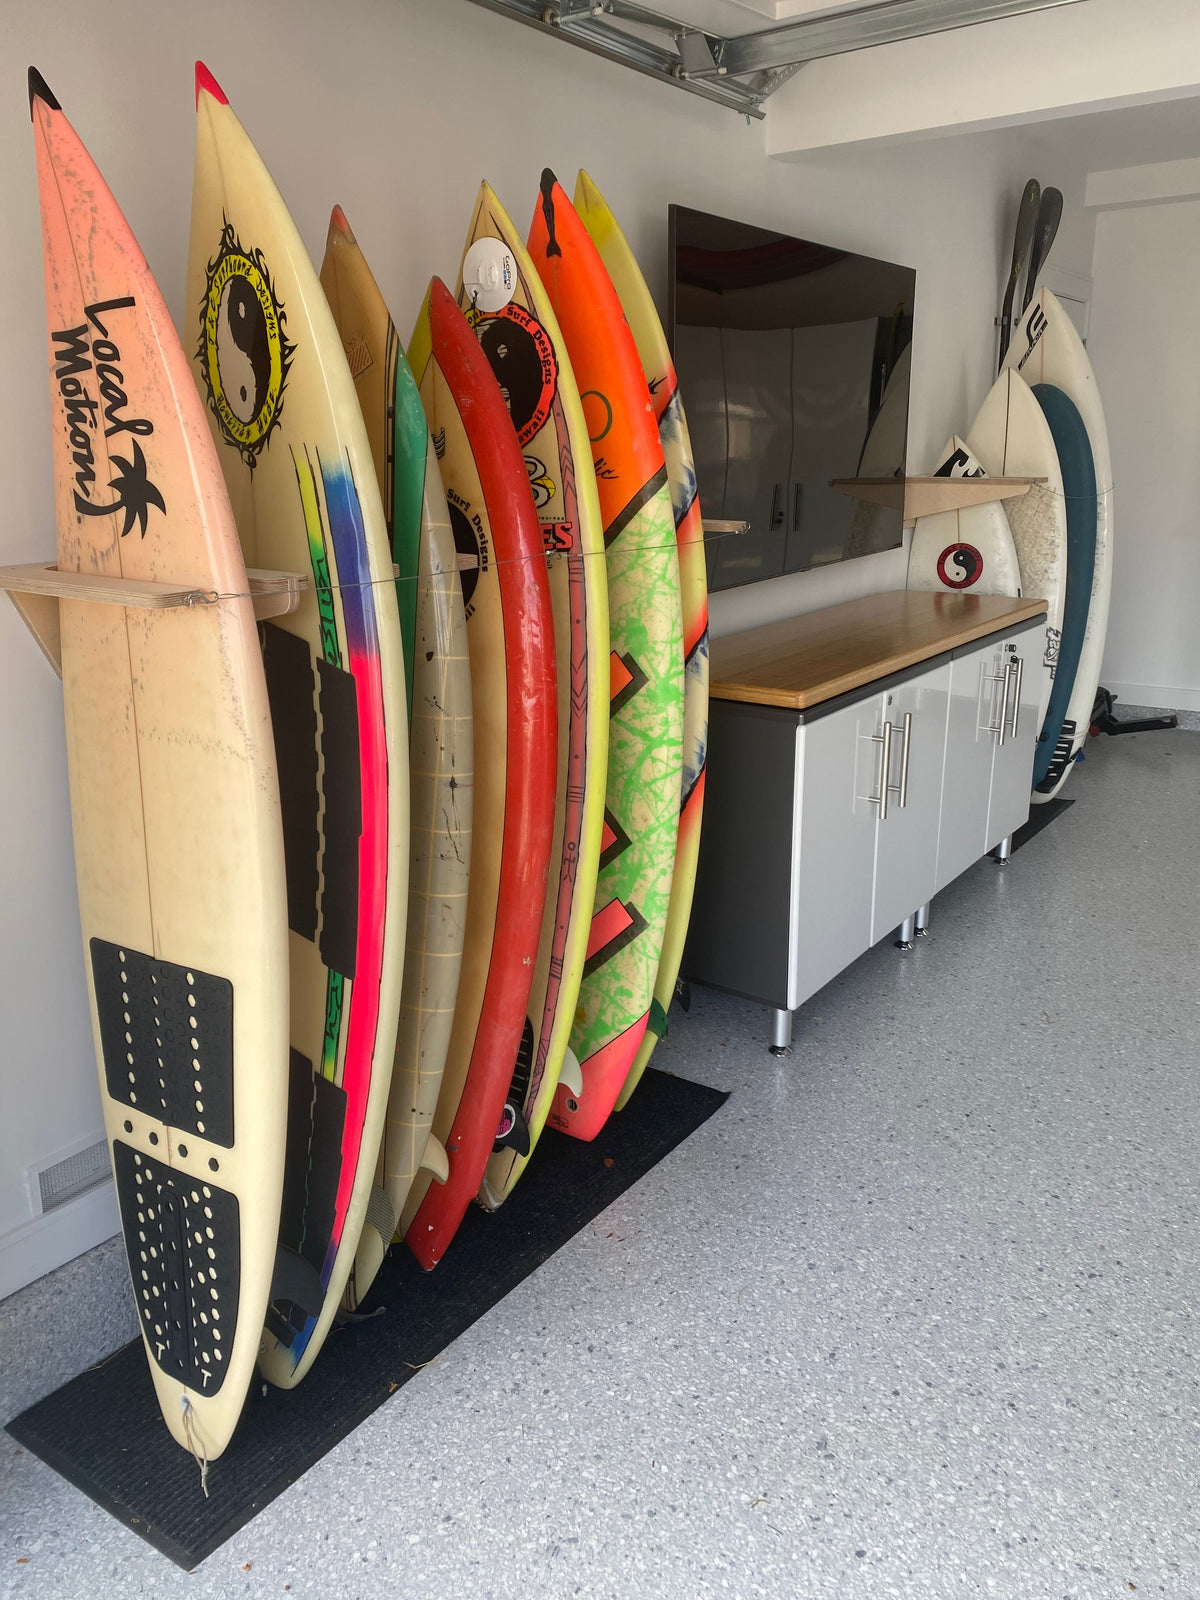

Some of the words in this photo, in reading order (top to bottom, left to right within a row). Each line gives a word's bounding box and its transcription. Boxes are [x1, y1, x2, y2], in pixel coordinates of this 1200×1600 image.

[84, 296, 154, 438] Local
[507, 306, 531, 328] Surf
[533, 330, 551, 385] Designs
[51, 324, 98, 498] Motion
[518, 409, 545, 444] awaii
[447, 488, 471, 511] Surf
[472, 514, 488, 573] Designs
